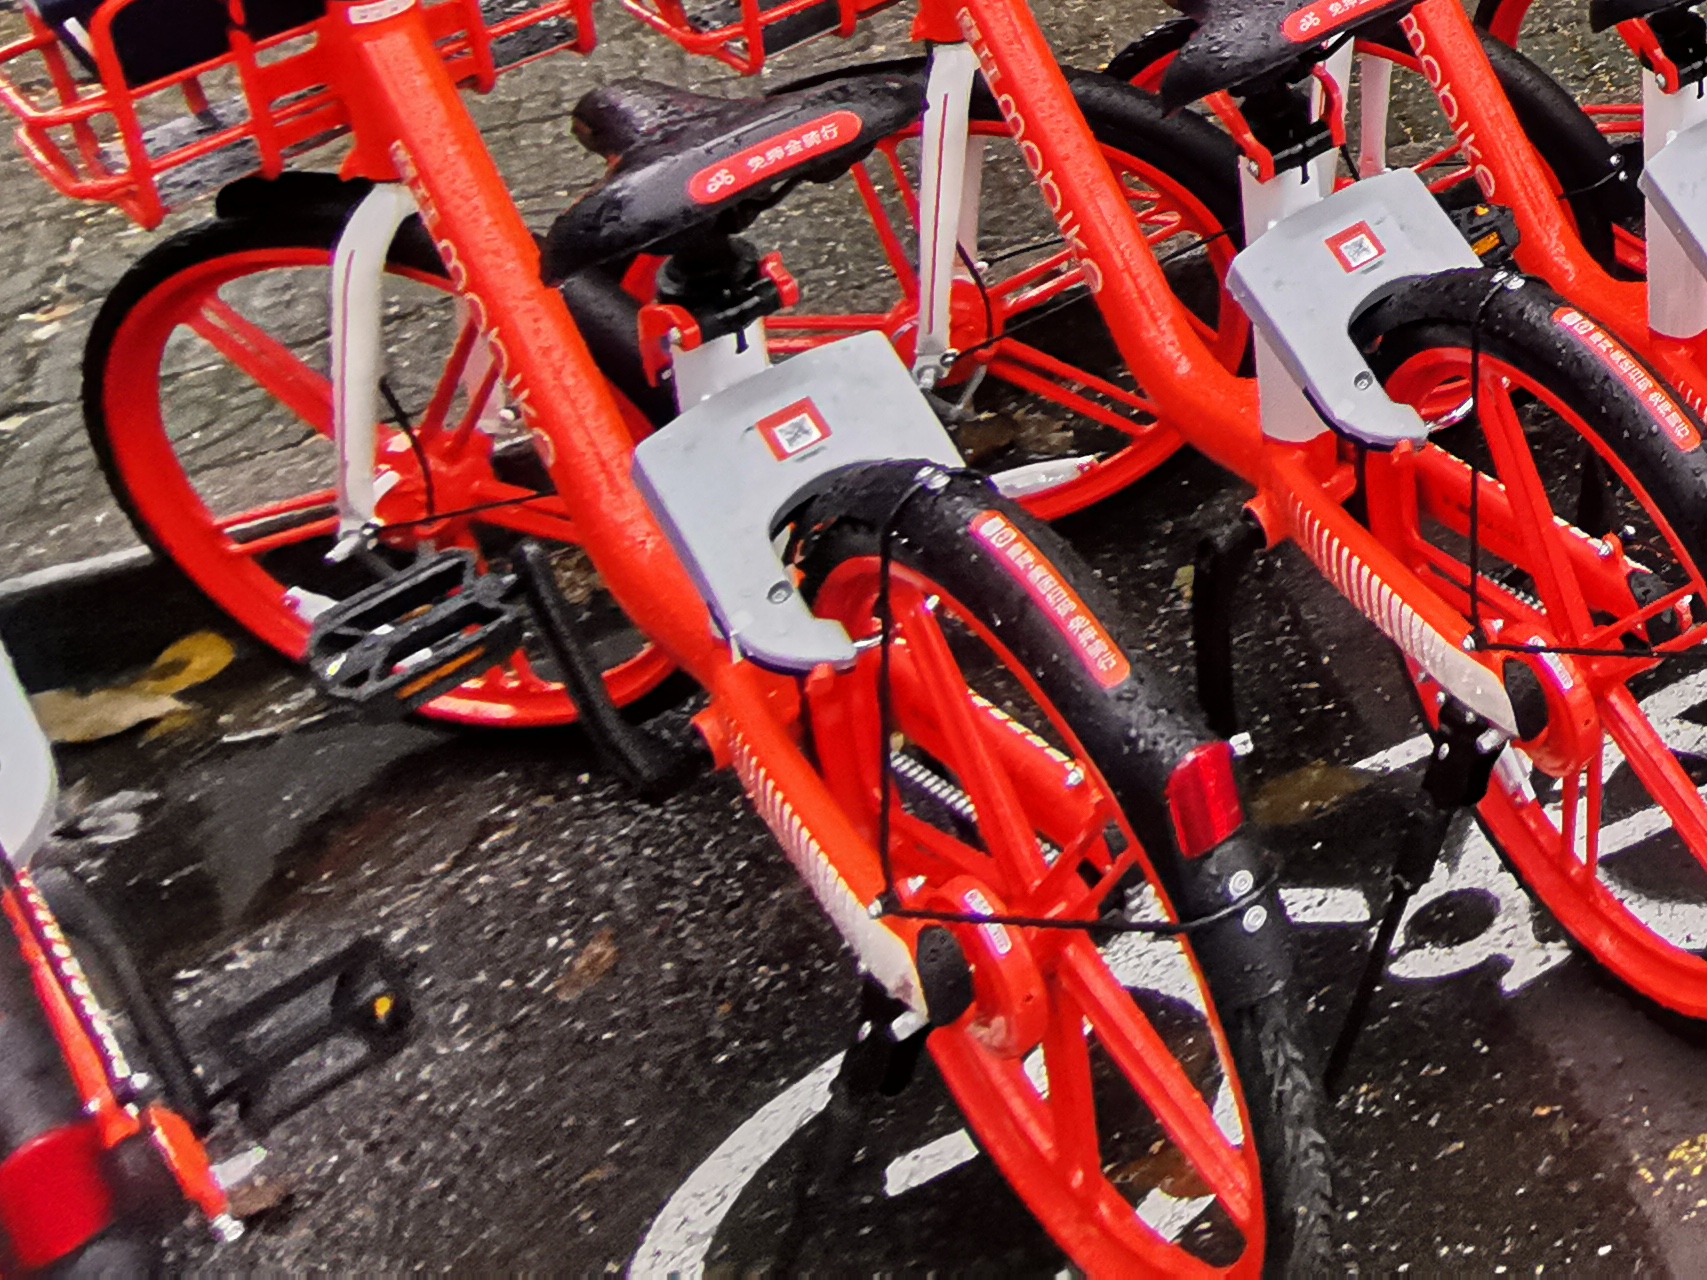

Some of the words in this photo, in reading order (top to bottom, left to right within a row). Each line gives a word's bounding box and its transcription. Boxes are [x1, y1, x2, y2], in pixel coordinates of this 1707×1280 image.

[746, 122, 840, 174] 免押金骑行
